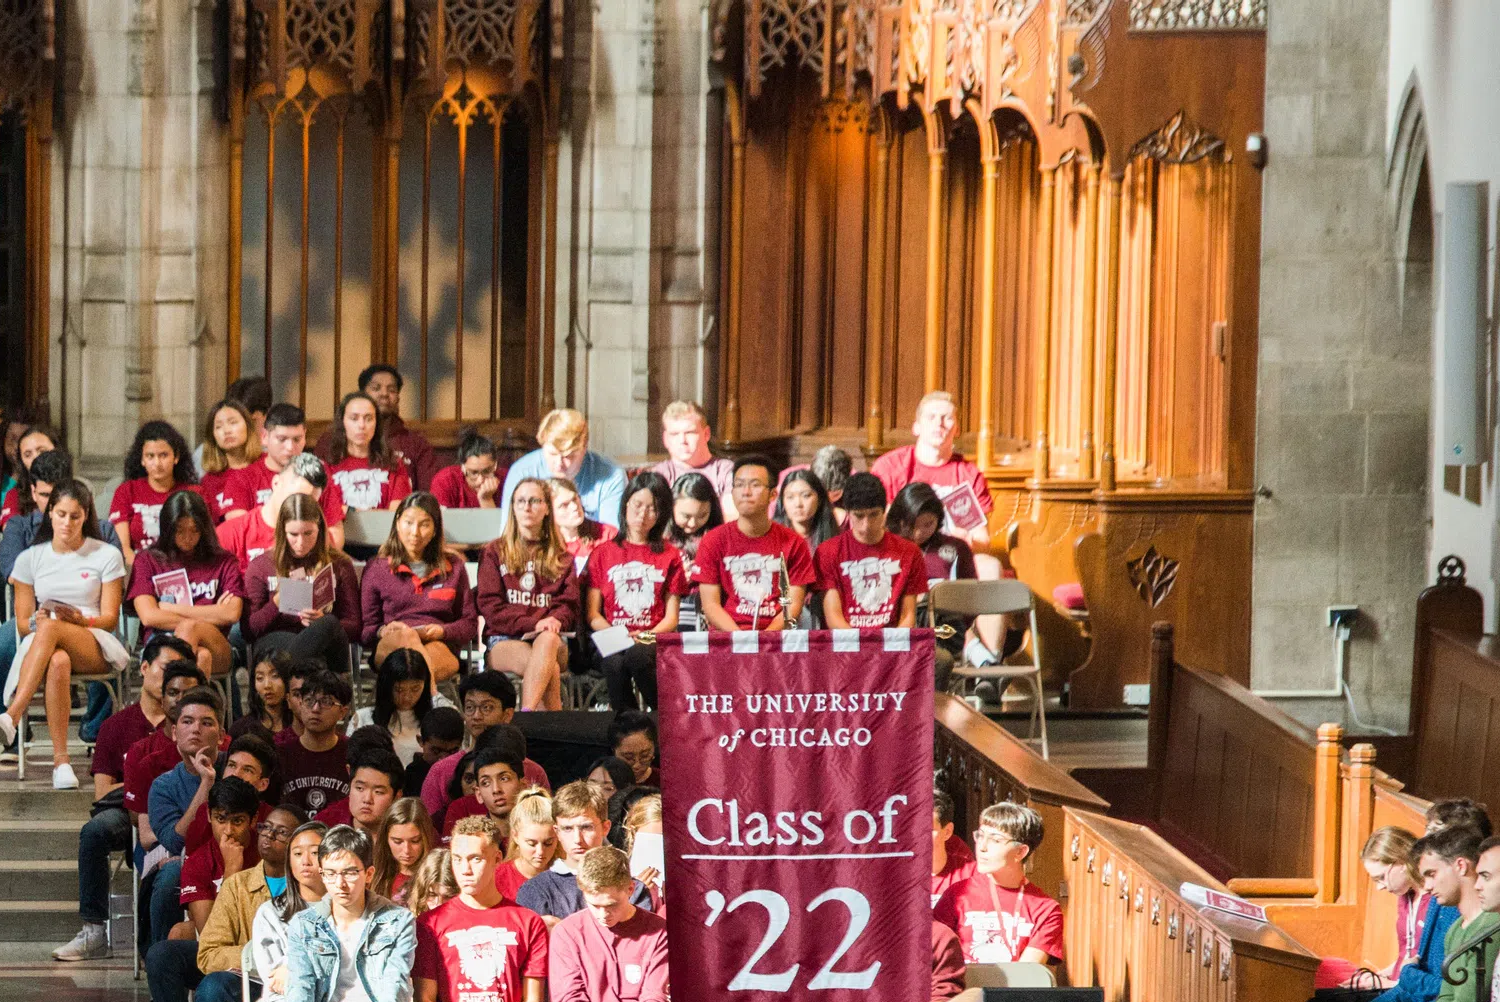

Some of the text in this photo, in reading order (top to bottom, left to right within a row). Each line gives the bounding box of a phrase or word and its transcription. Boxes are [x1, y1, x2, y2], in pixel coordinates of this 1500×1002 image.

[685, 691, 907, 714] THE UNIVERSITY
[718, 727, 872, 753] of CHICAGO
[295, 776, 342, 791] UNIVERSITY
[686, 794, 908, 847] Class of
